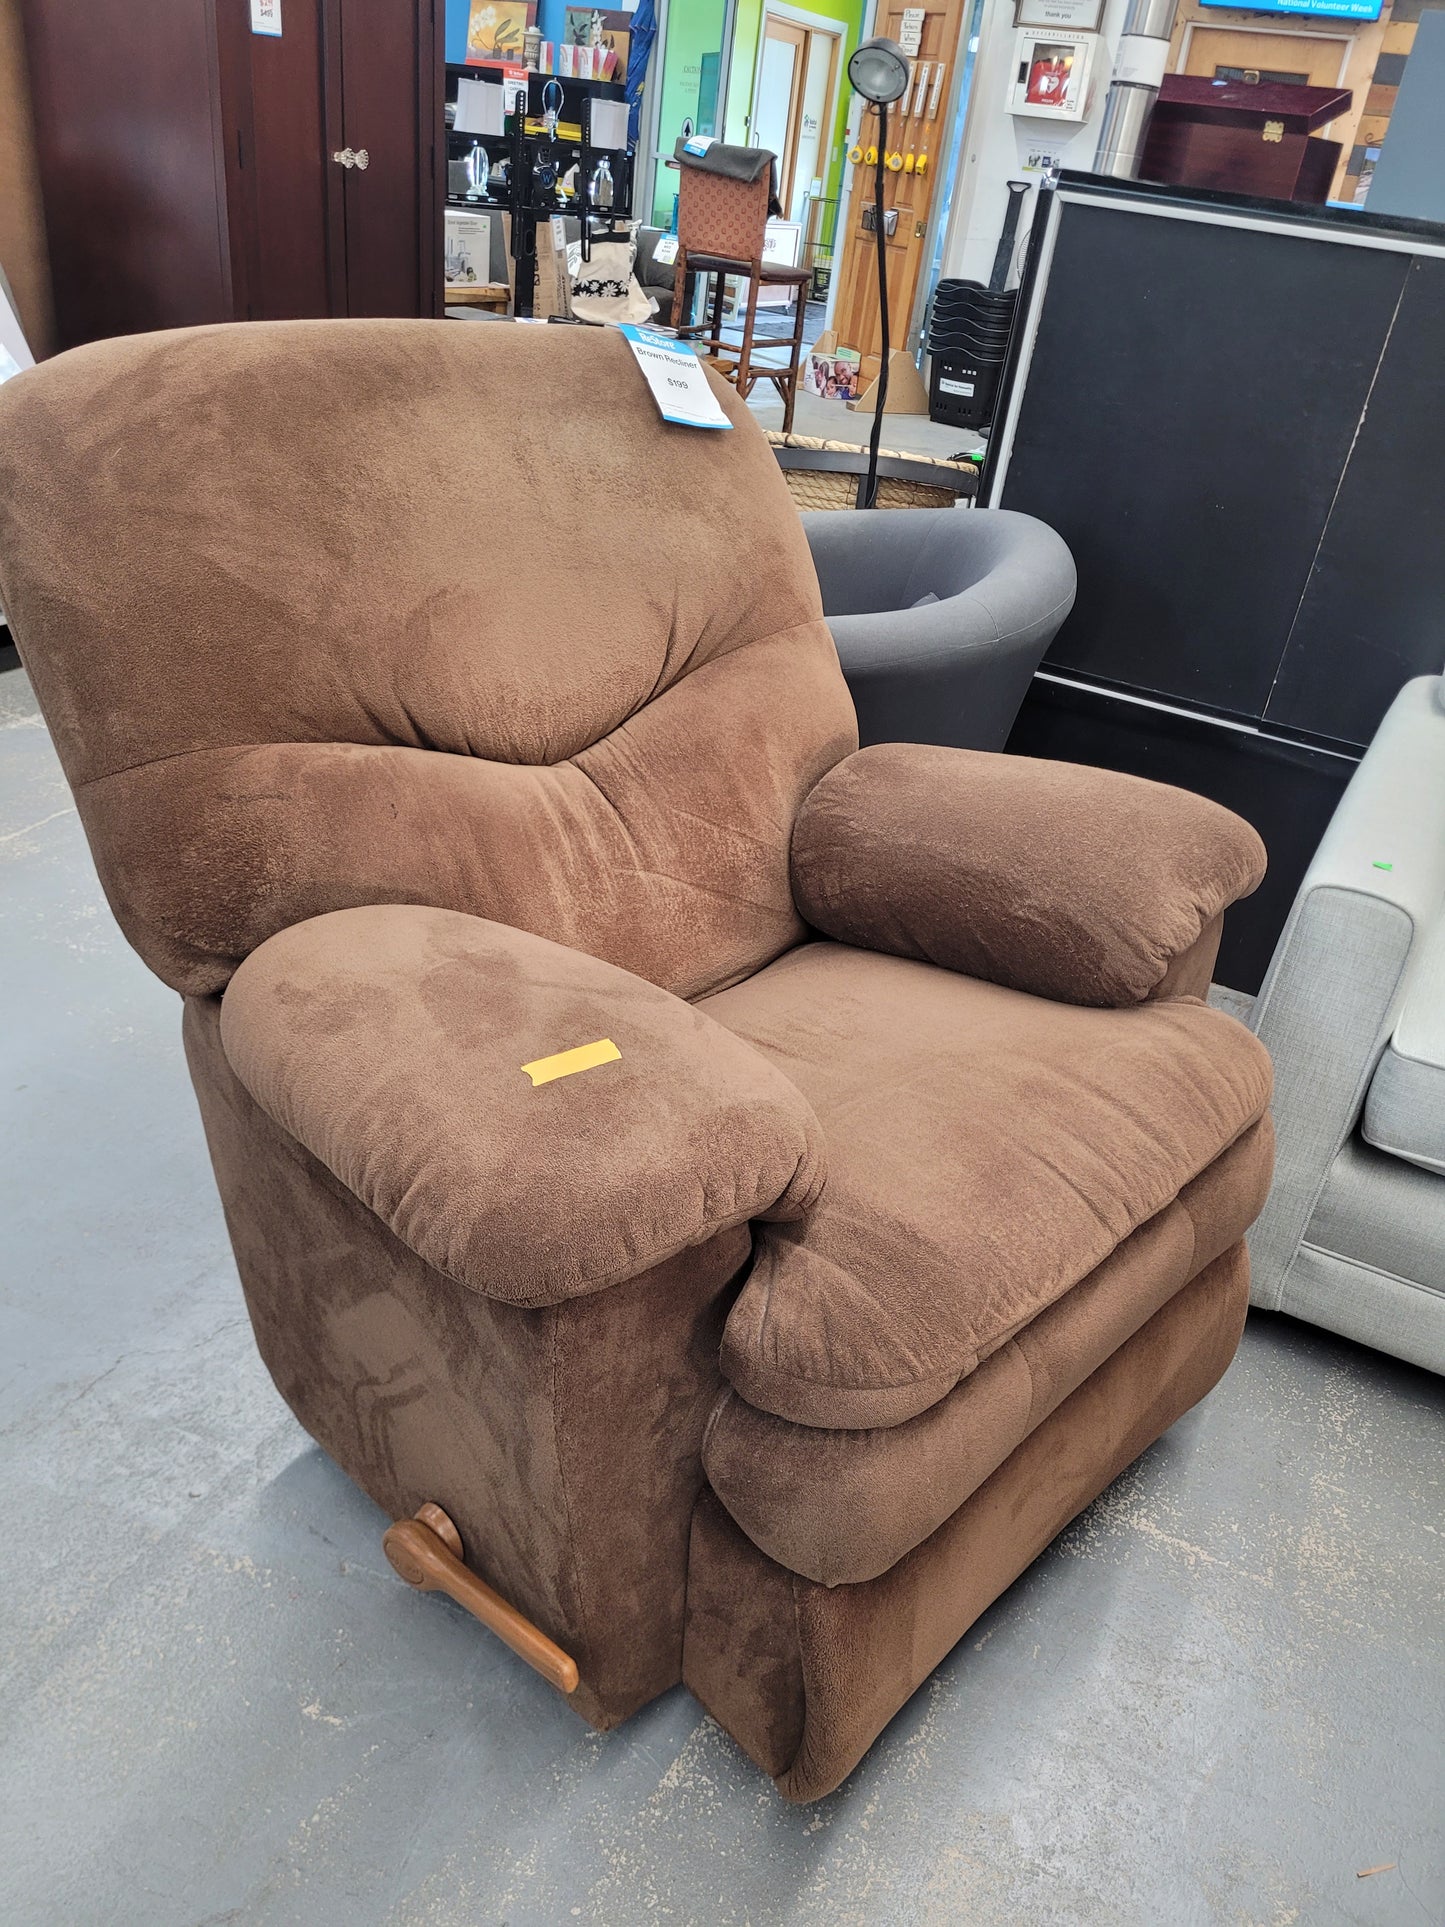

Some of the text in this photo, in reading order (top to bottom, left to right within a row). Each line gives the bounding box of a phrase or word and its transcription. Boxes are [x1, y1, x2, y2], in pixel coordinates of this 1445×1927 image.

[1311, 0, 1350, 11] Volunteer
[1350, 3, 1373, 13] Week
[543, 174, 551, 183] W
[636, 346, 698, 369] Brown Recliner
[667, 377, 689, 390] $199
